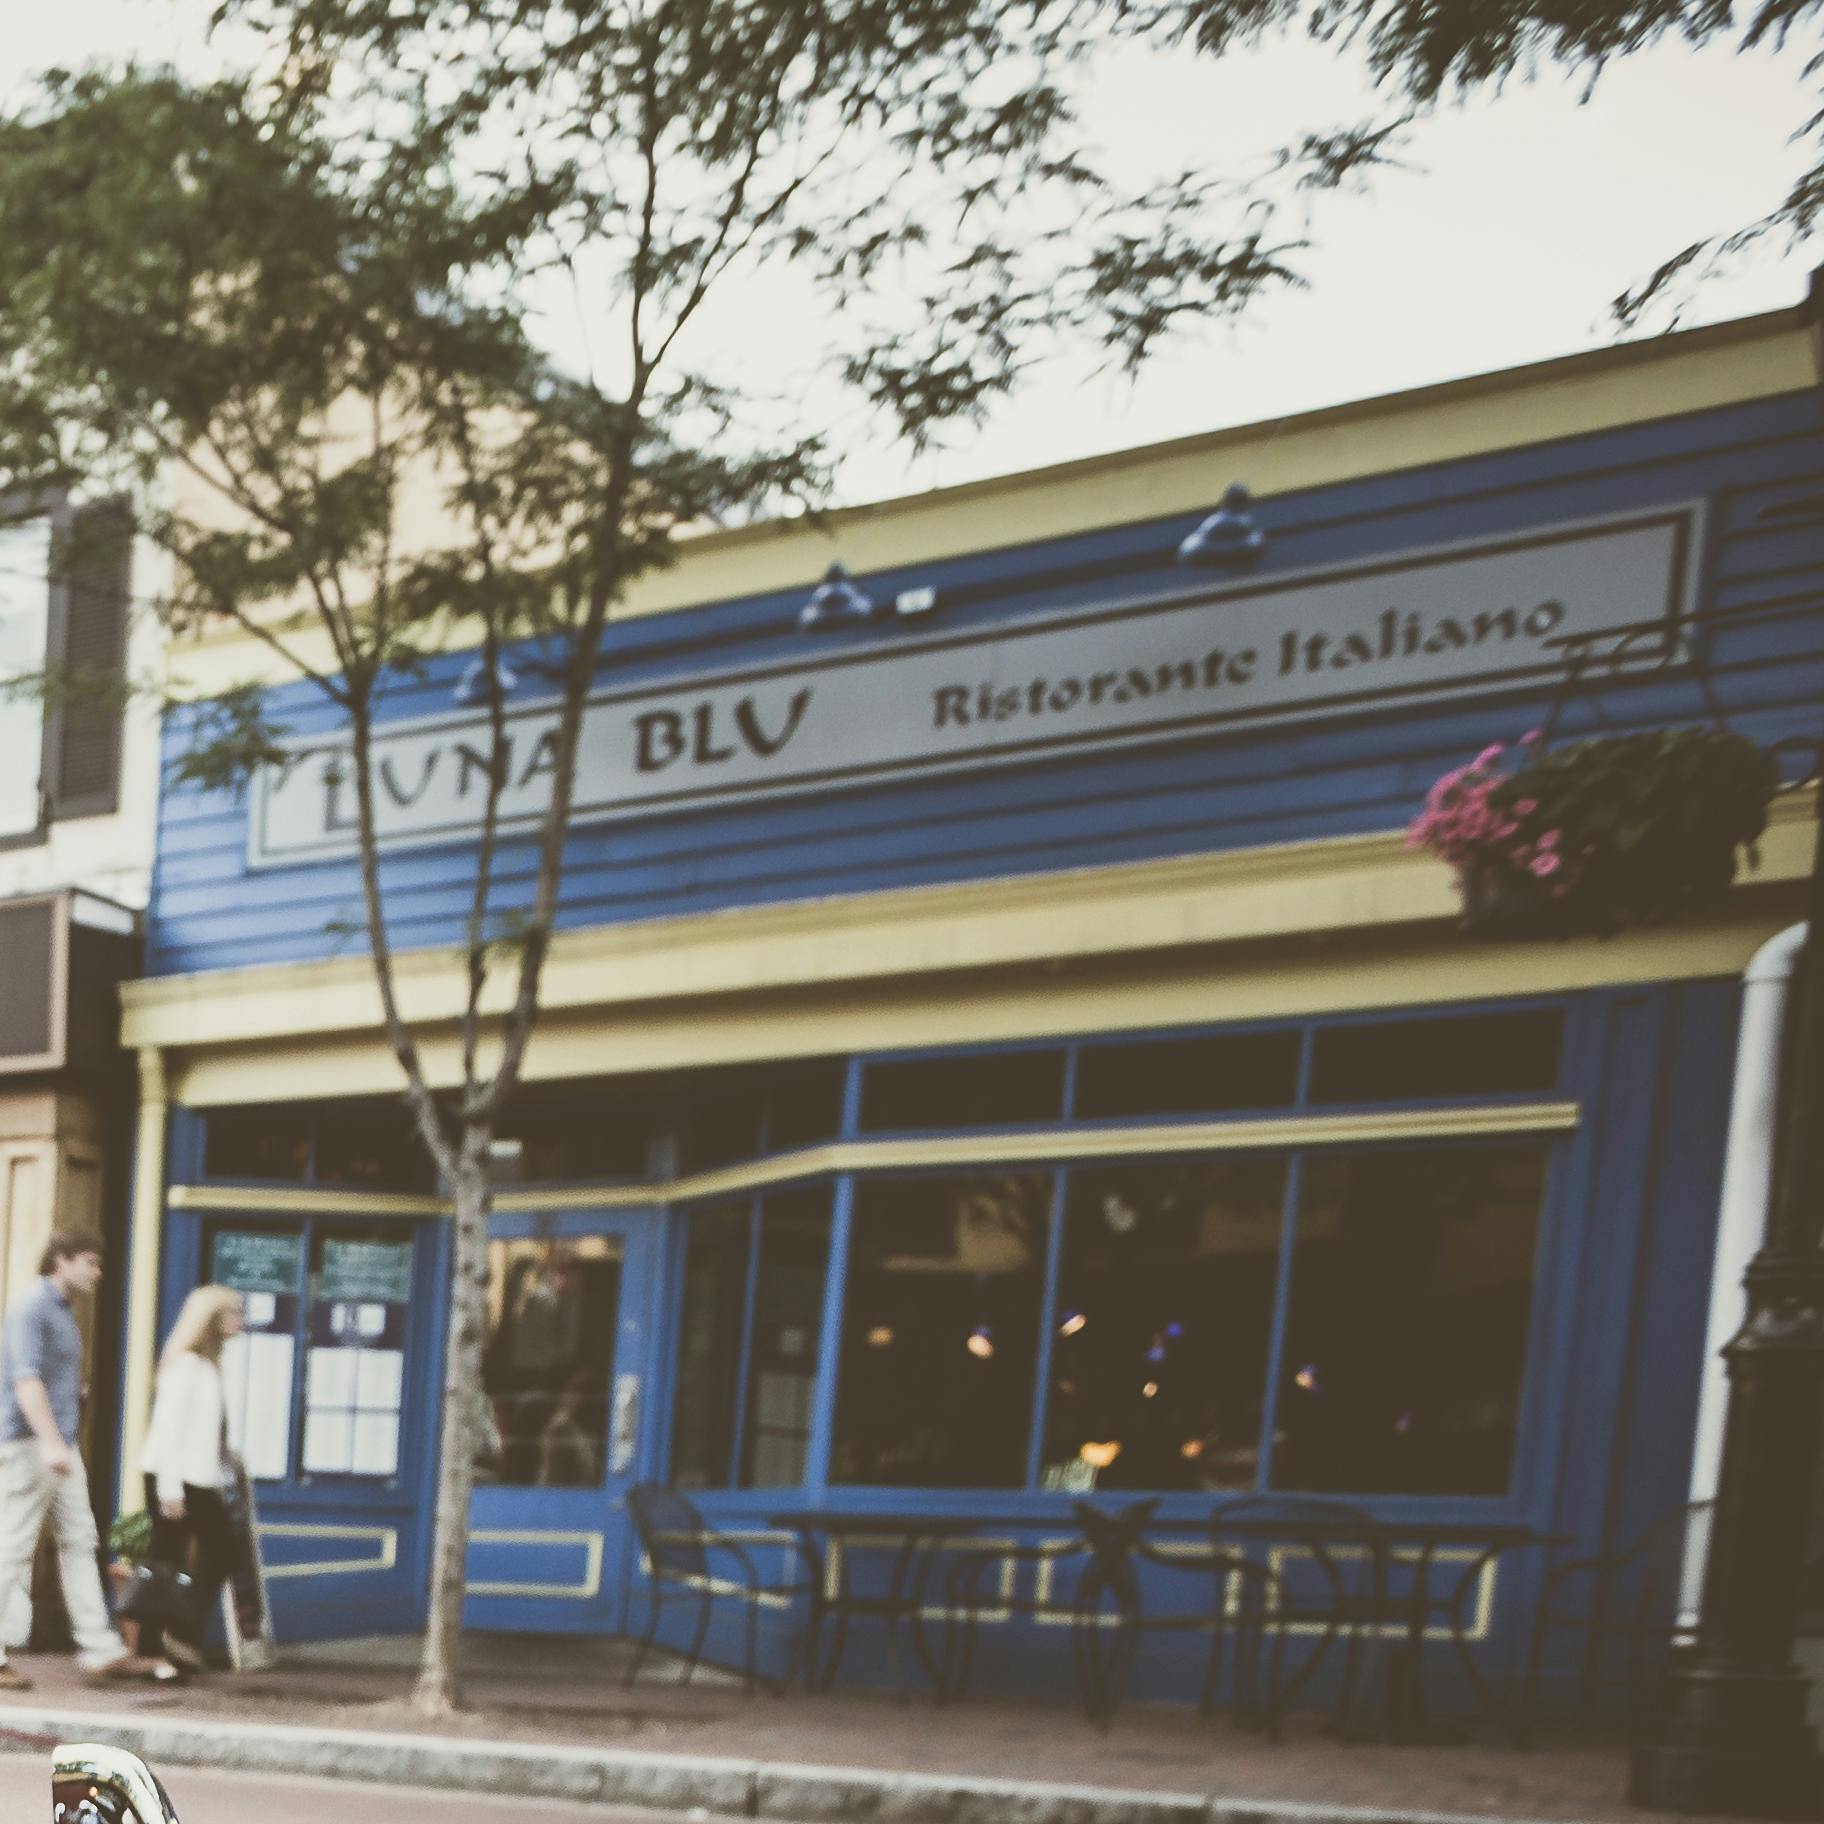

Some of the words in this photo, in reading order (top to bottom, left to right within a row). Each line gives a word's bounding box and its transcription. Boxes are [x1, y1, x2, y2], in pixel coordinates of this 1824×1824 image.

[931, 643, 1260, 730] Ristorante
[1276, 600, 1565, 678] Italiano
[630, 686, 813, 775] BLU
